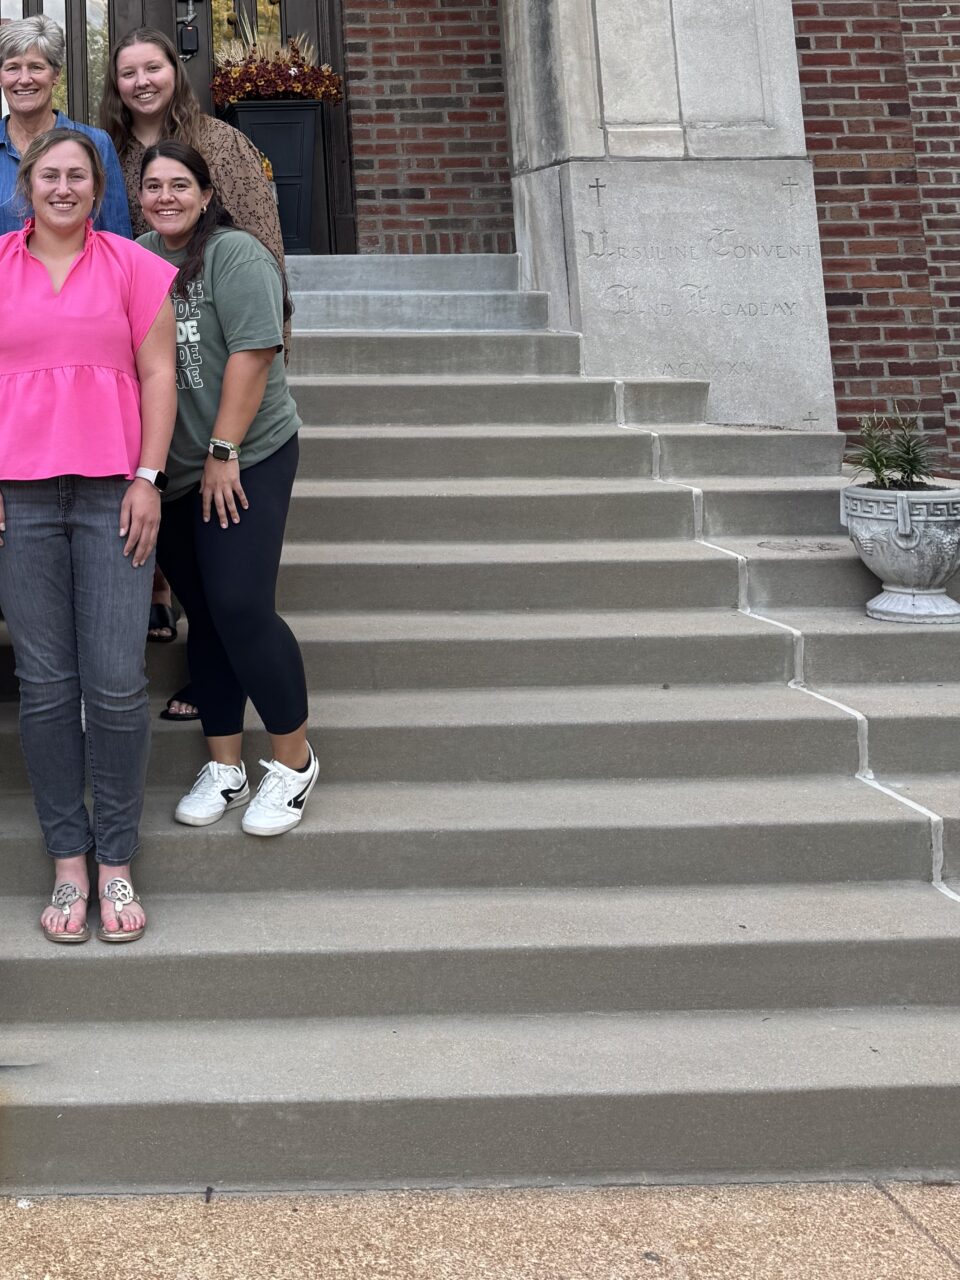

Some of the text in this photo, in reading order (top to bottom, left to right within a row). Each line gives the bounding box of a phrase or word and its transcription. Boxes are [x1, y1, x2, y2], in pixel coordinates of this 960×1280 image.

[581, 227, 815, 260] URSULINE CONVENT
[678, 283, 799, 317] ACADEMY
